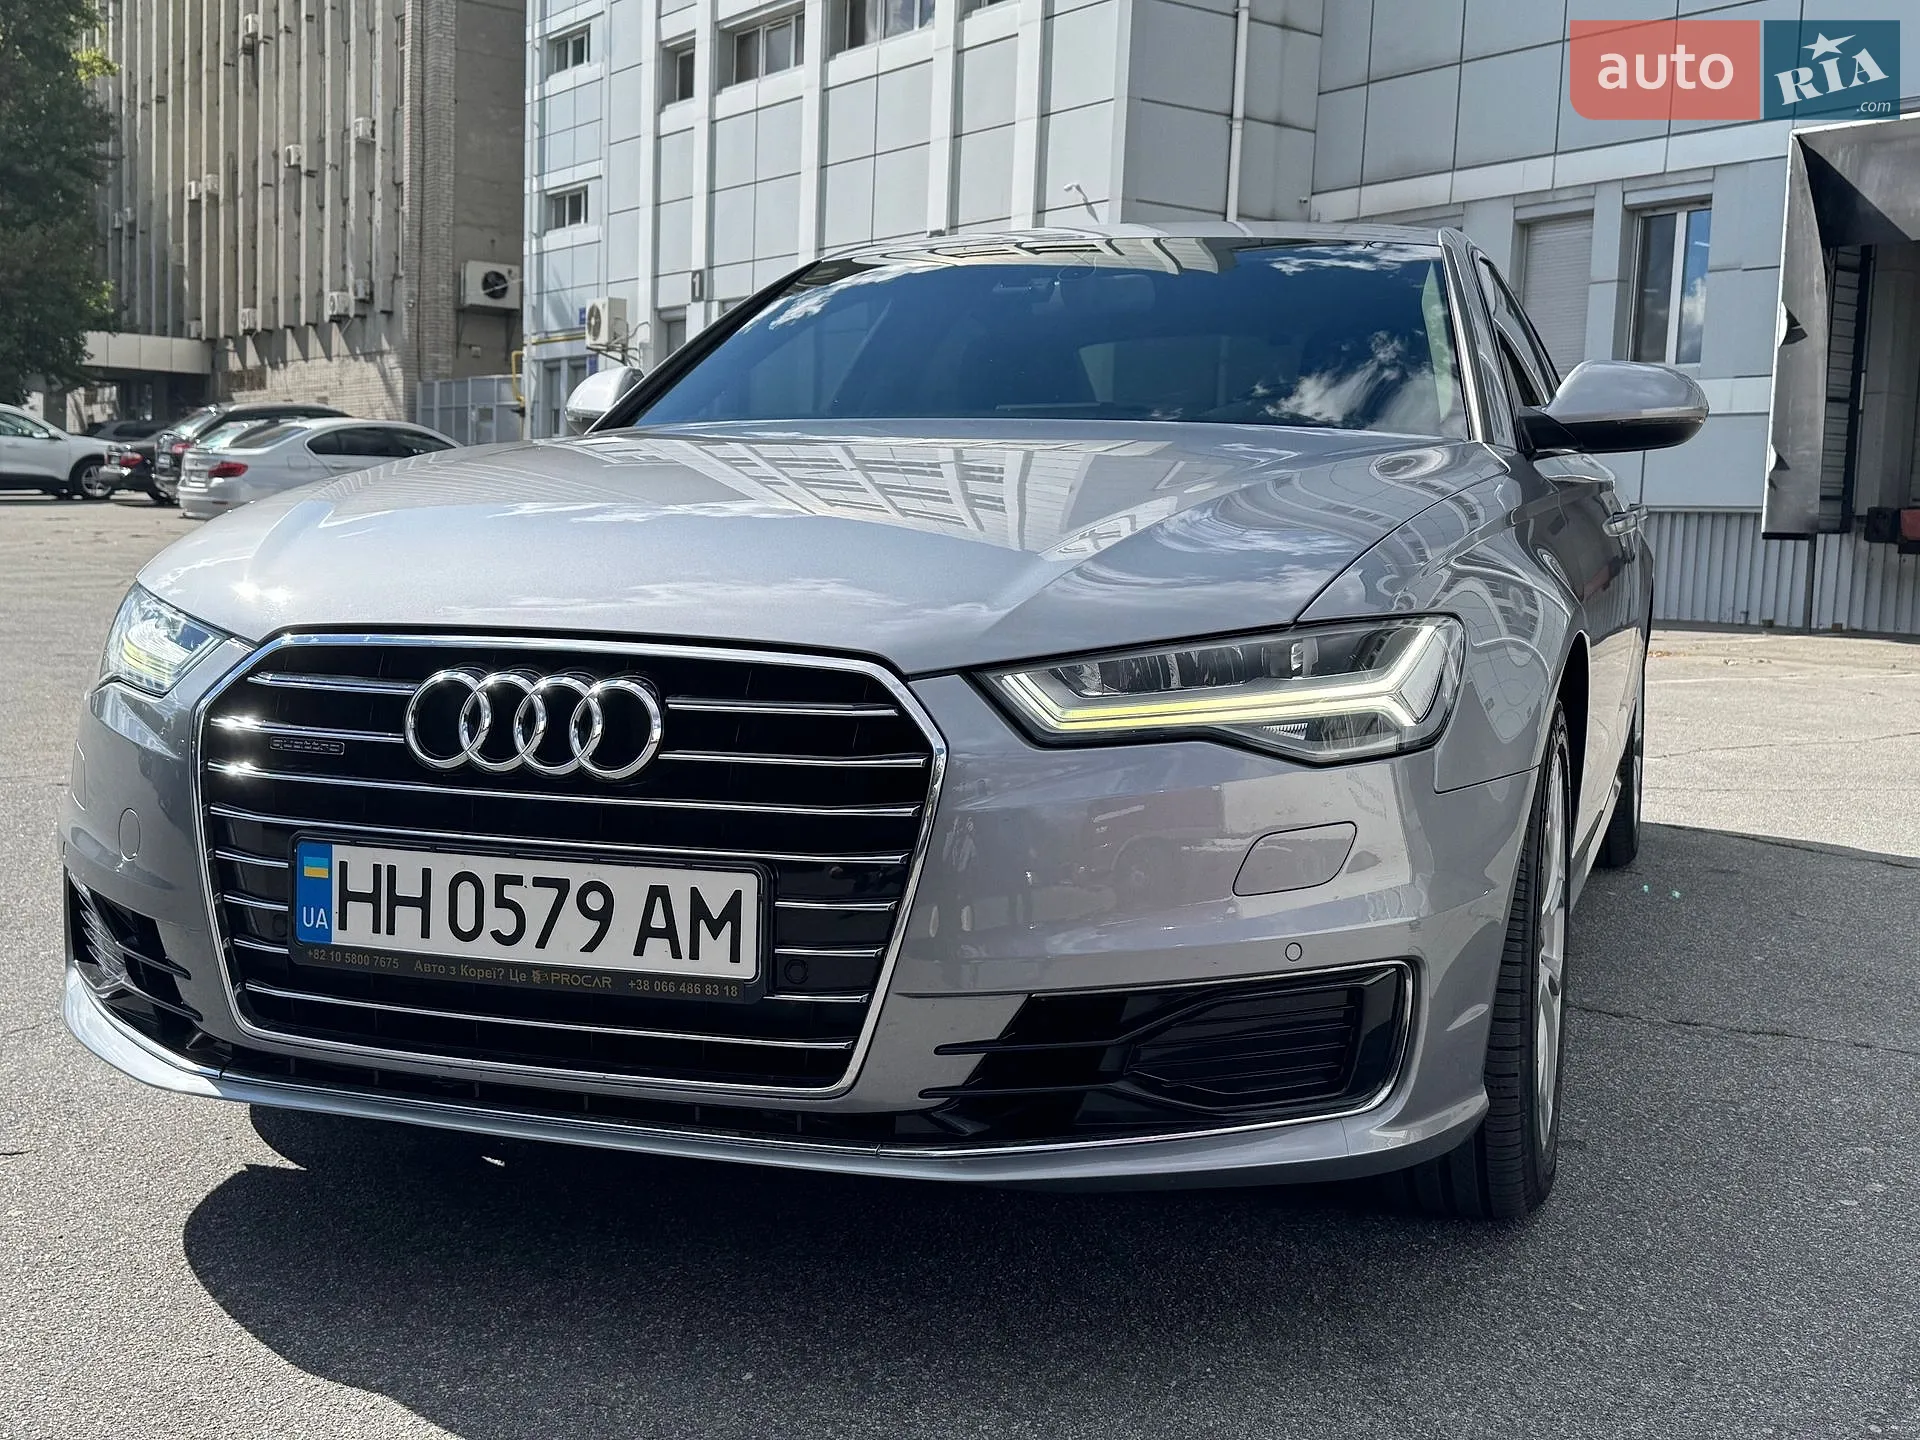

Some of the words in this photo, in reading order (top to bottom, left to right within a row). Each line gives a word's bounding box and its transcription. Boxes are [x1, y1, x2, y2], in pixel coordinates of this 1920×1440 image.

[693, 272, 700, 298] 1
[302, 906, 329, 930] UA
[338, 860, 432, 939] HH
[448, 870, 615, 953] 0579
[633, 884, 743, 964] AM
[308, 949, 326, 962] +82
[330, 951, 342, 963] 10
[345, 953, 371, 967] 5800
[373, 956, 399, 970] 7675
[414, 960, 446, 975] Авто
[450, 966, 456, 976] з
[460, 964, 505, 981] Кореї?
[509, 969, 527, 983] Це
[551, 972, 612, 989] PROCAR
[628, 978, 650, 992] +38
[654, 980, 675, 993] 066
[679, 981, 701, 995] 486
[705, 983, 719, 996] 83
[723, 985, 738, 998] 18
